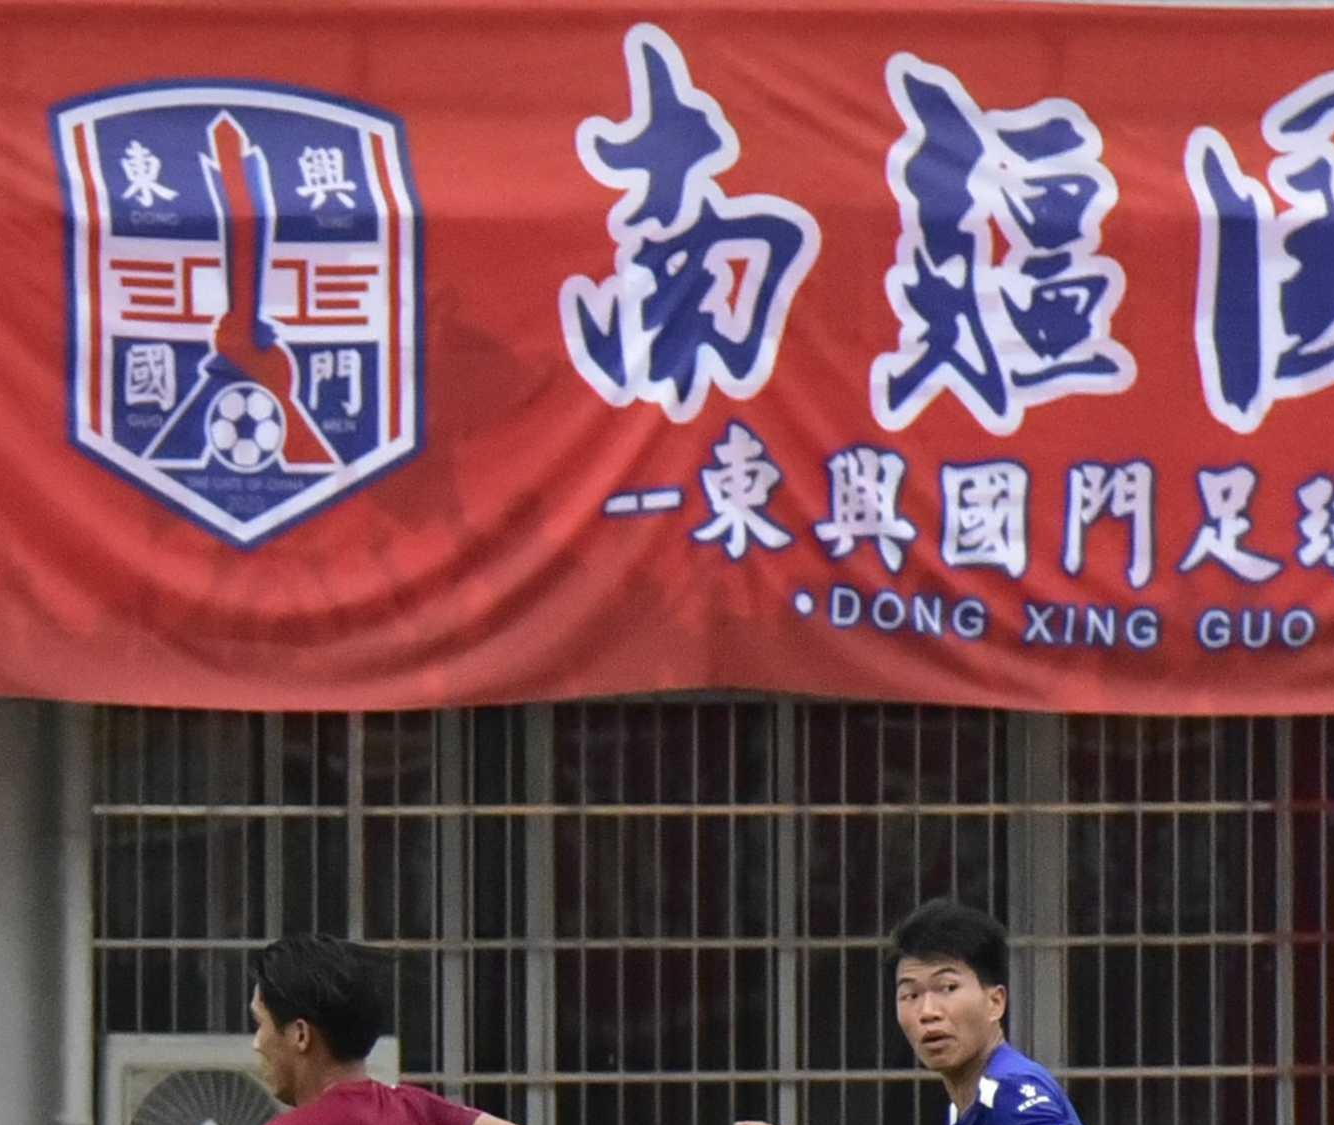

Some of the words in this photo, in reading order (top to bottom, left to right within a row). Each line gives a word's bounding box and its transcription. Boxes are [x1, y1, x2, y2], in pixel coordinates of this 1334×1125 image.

[120, 139, 181, 208] 東
[294, 145, 358, 210] 興
[124, 342, 177, 412] 國
[308, 349, 363, 416] 門
[830, 587, 986, 638] DONG
[1024, 604, 1160, 648] XING
[1198, 608, 1317, 649] GUO
